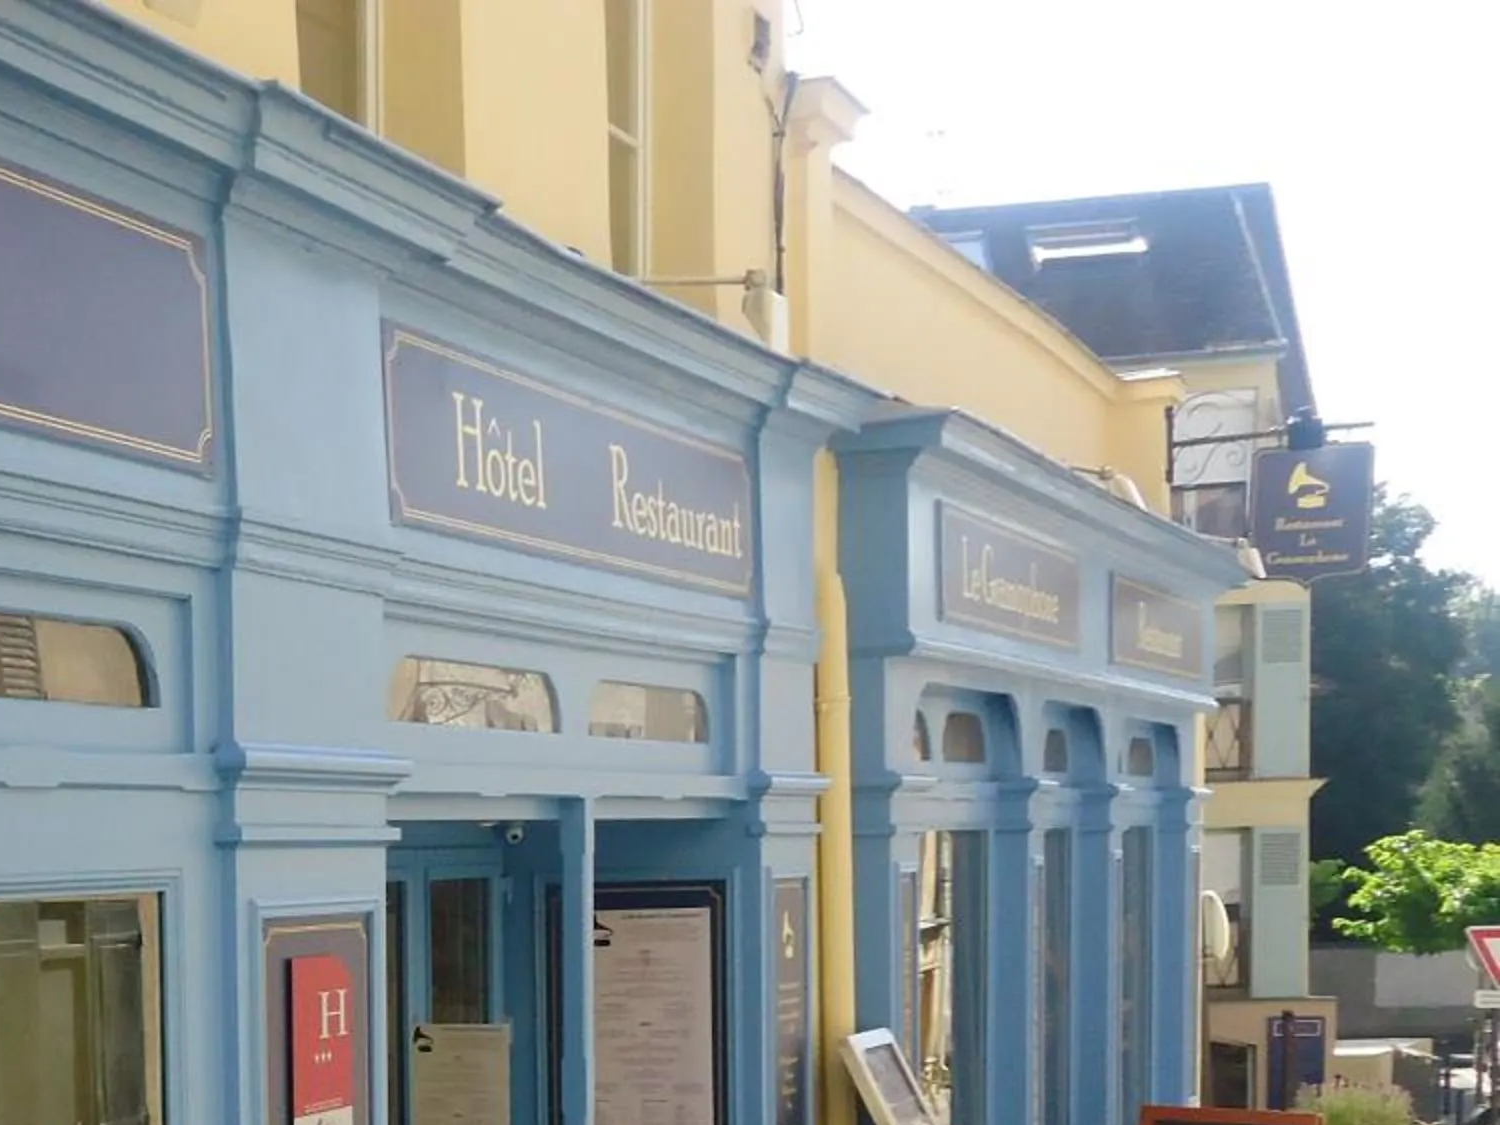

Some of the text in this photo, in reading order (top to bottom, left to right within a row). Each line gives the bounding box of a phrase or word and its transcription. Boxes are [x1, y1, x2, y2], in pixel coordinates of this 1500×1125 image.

[452, 391, 743, 560] Hôtel Restaurant
[317, 988, 350, 1040] H
